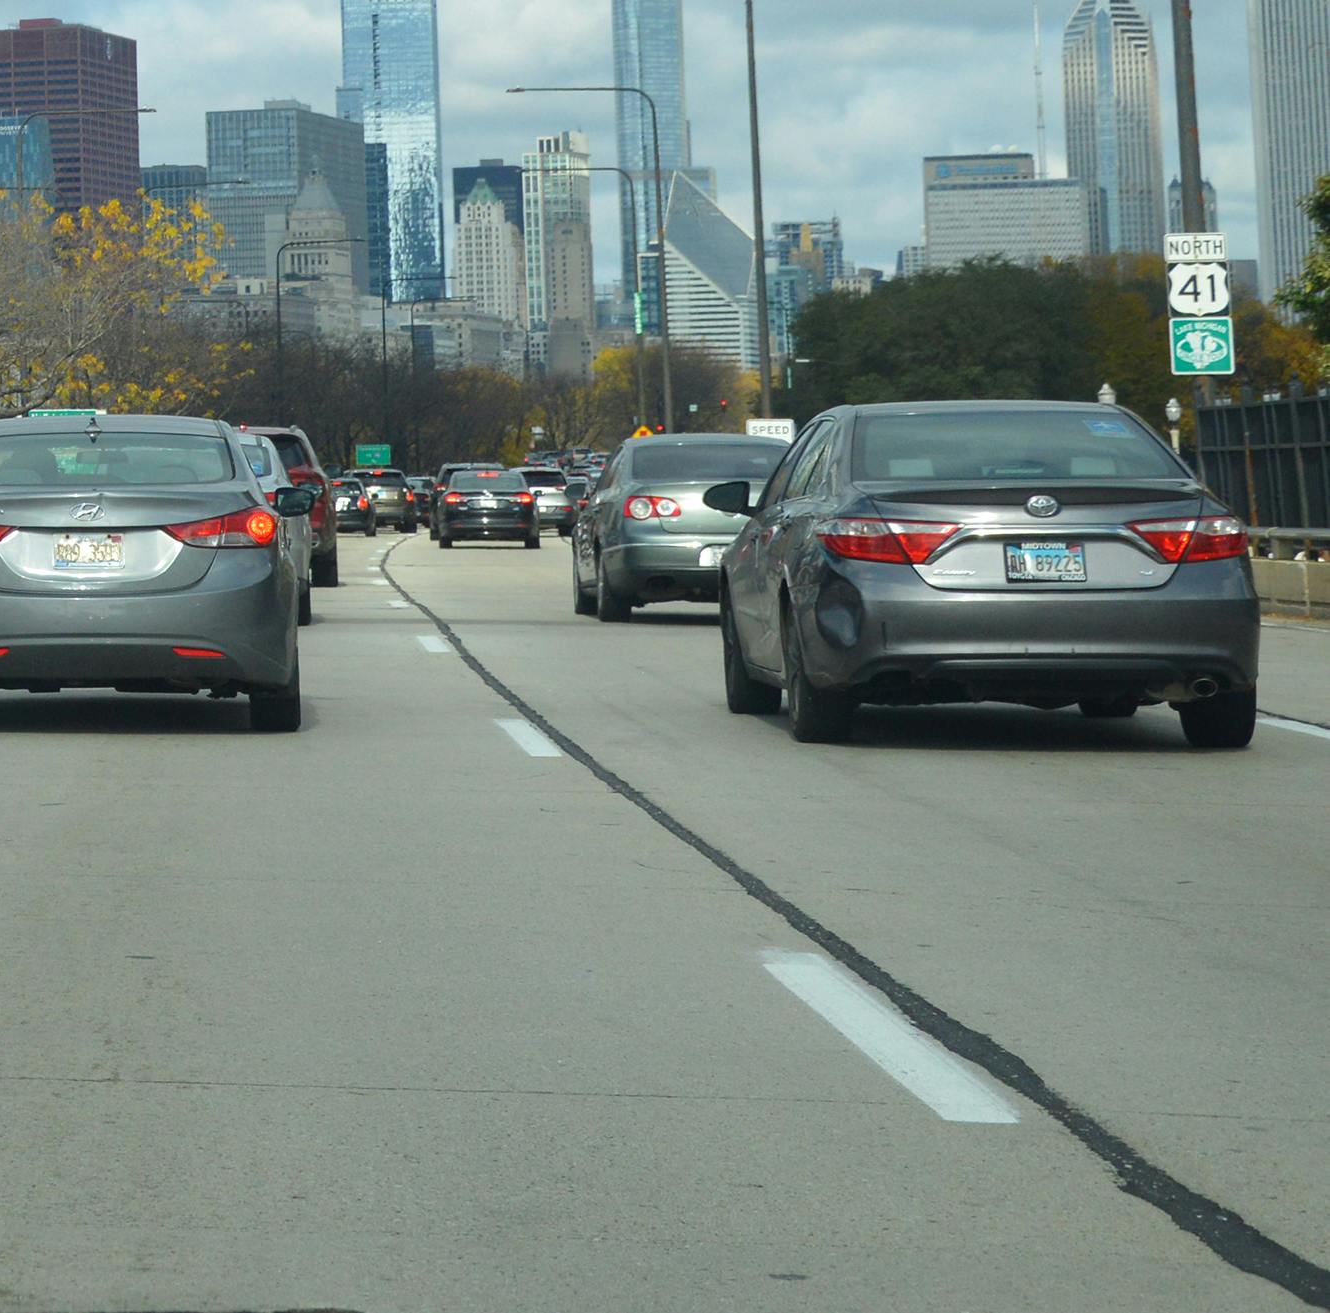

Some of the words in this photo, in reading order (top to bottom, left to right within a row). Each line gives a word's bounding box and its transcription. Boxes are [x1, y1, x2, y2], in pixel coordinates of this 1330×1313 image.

[1169, 240, 1223, 255] NORTH
[1178, 274, 1215, 303] 41
[752, 425, 789, 435] SPEED
[1036, 555, 1081, 572] 89225
